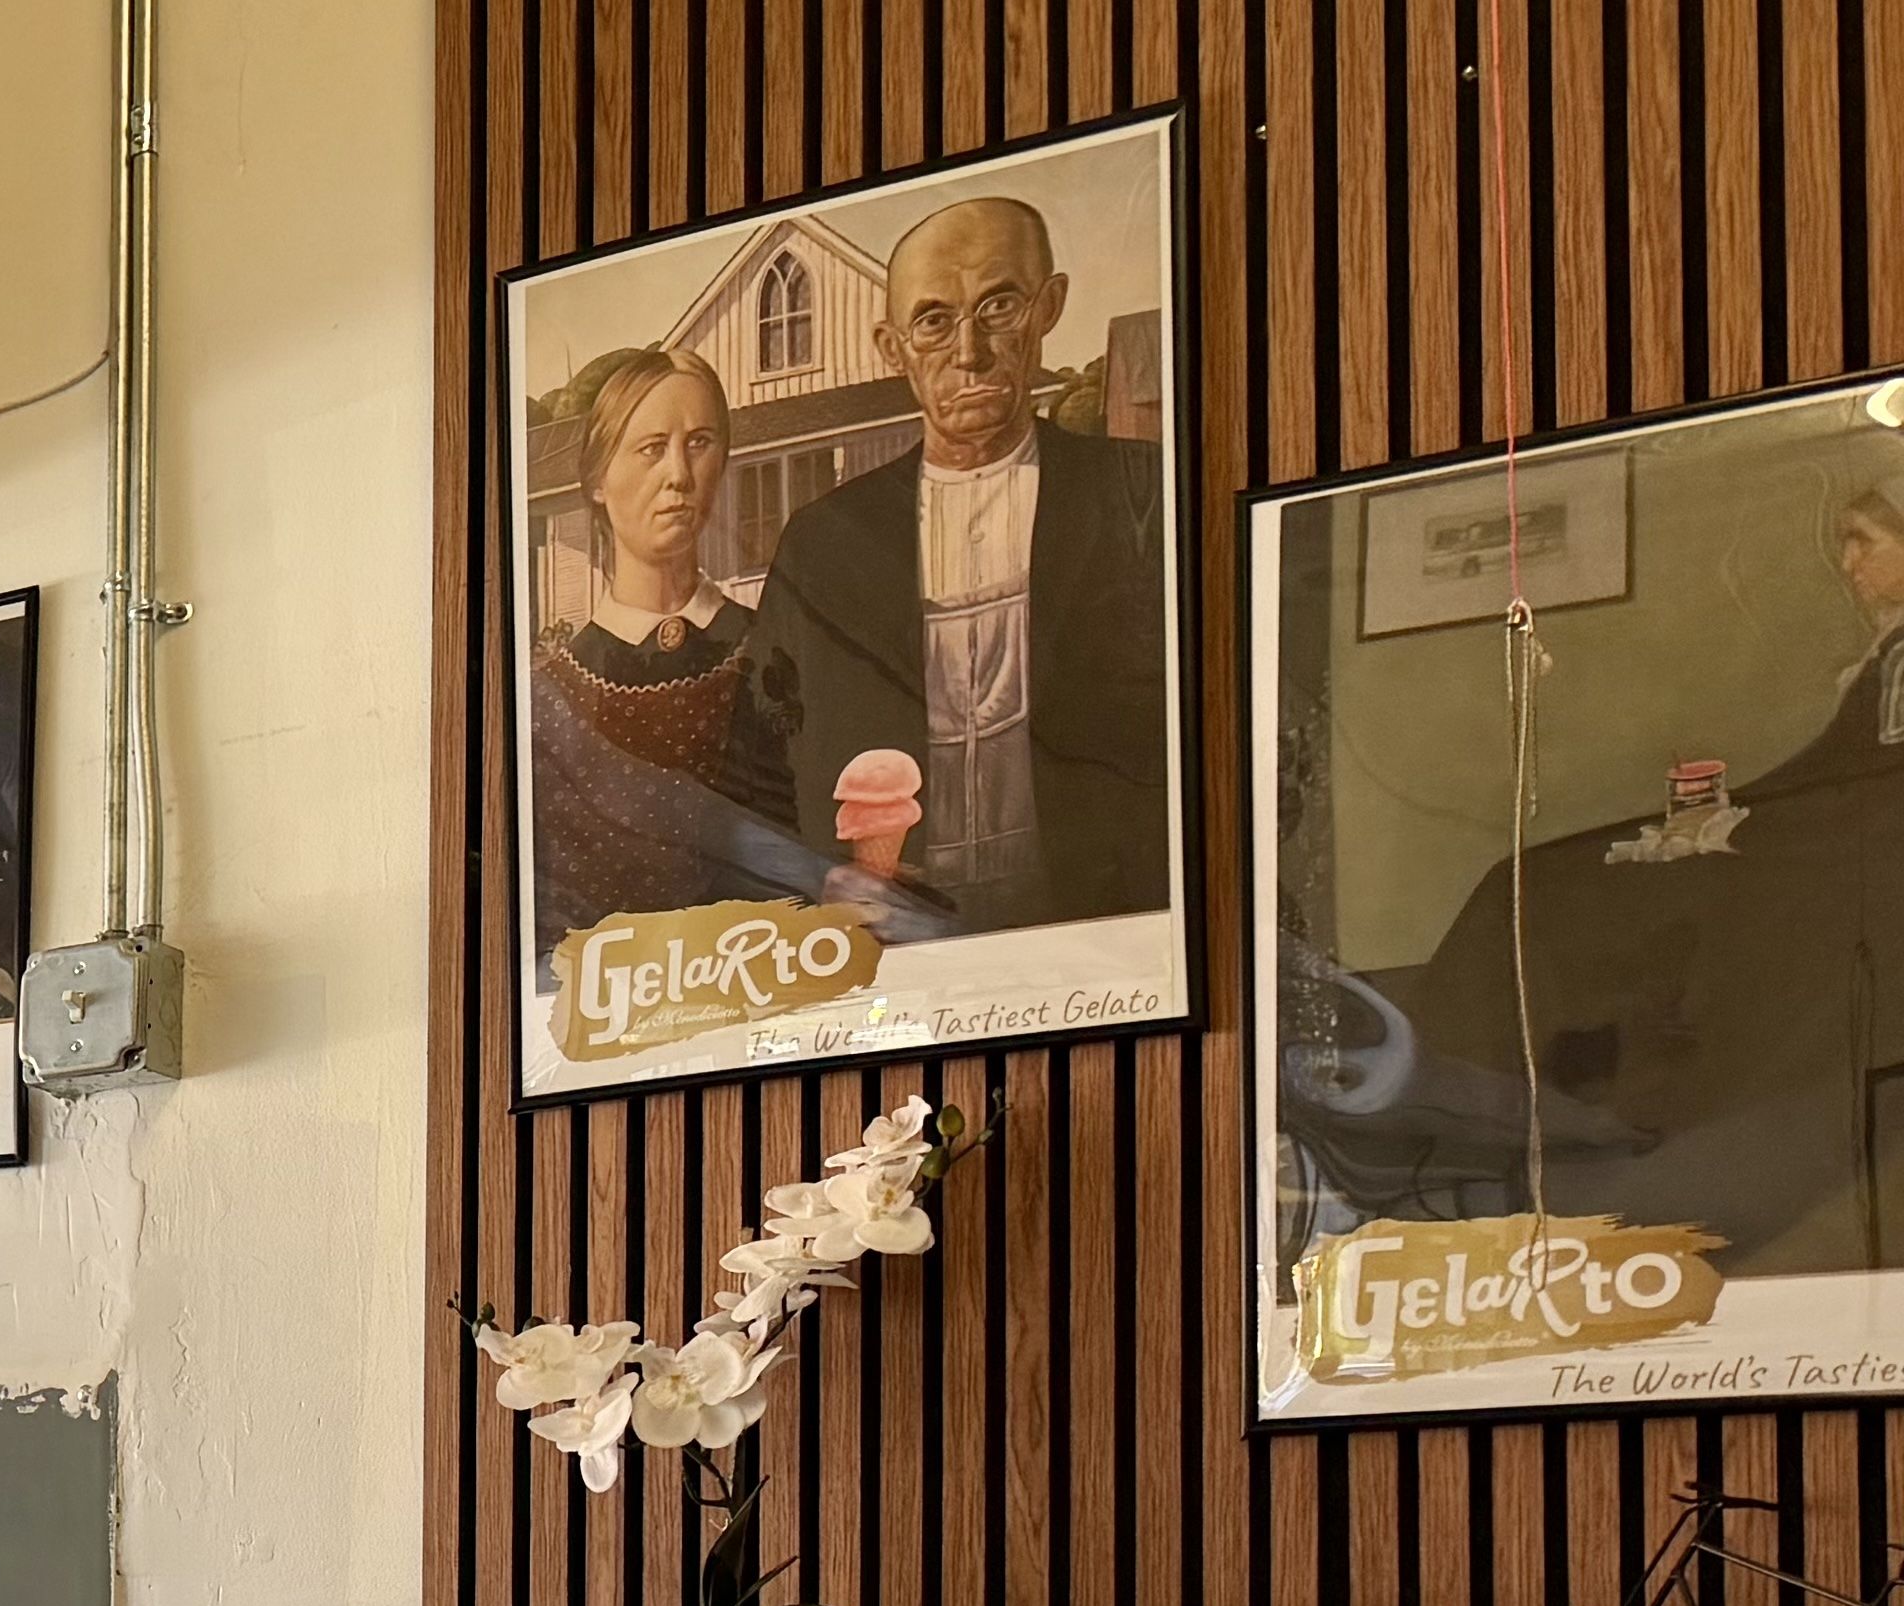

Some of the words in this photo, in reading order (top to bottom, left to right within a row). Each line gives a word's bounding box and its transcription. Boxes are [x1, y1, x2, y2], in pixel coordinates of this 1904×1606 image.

[931, 1002, 1049, 1039] Tastiest
[1063, 989, 1160, 1023] Gelato
[1551, 1363, 1615, 1398] The
[1632, 1354, 1768, 1395] World's
